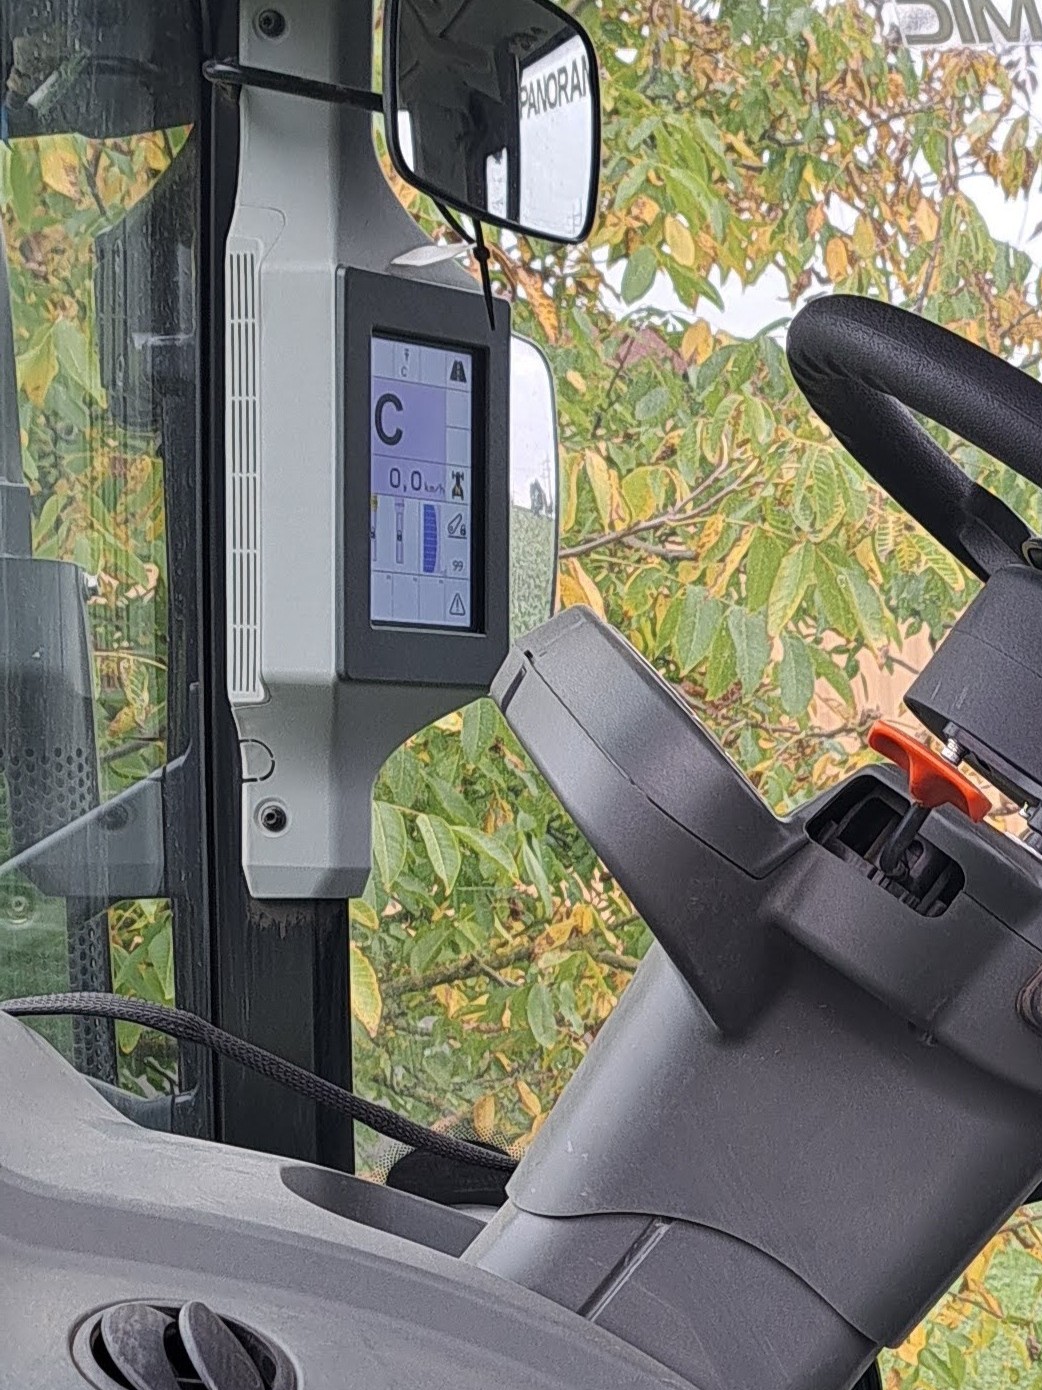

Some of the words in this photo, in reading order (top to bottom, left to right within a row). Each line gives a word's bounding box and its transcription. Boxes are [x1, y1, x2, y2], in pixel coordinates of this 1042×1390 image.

[401, 366, 408, 377] C
[375, 393, 404, 446] C
[452, 560, 464, 572] 99
